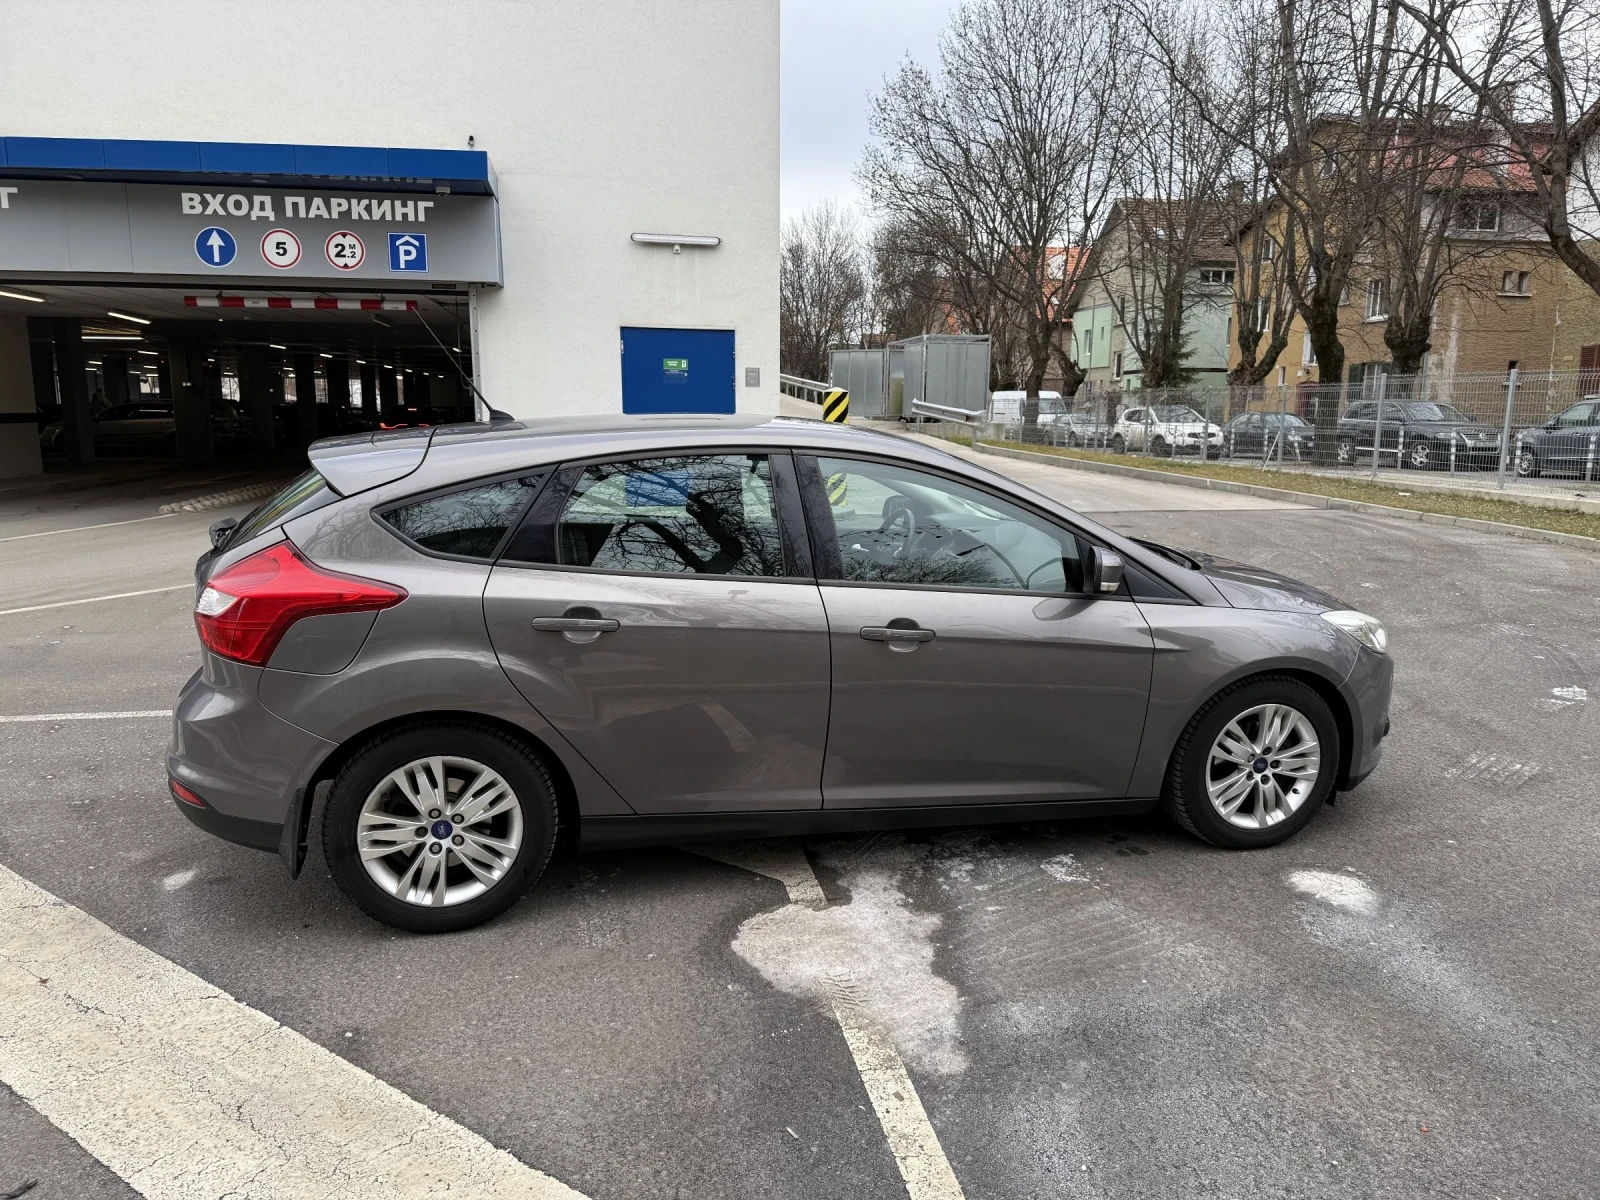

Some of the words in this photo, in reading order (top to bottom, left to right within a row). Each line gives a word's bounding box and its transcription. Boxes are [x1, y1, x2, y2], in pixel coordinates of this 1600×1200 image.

[181, 192, 275, 221] ВХОД
[284, 195, 434, 222] ПАРКИНГ
[275, 241, 288, 257] 5
